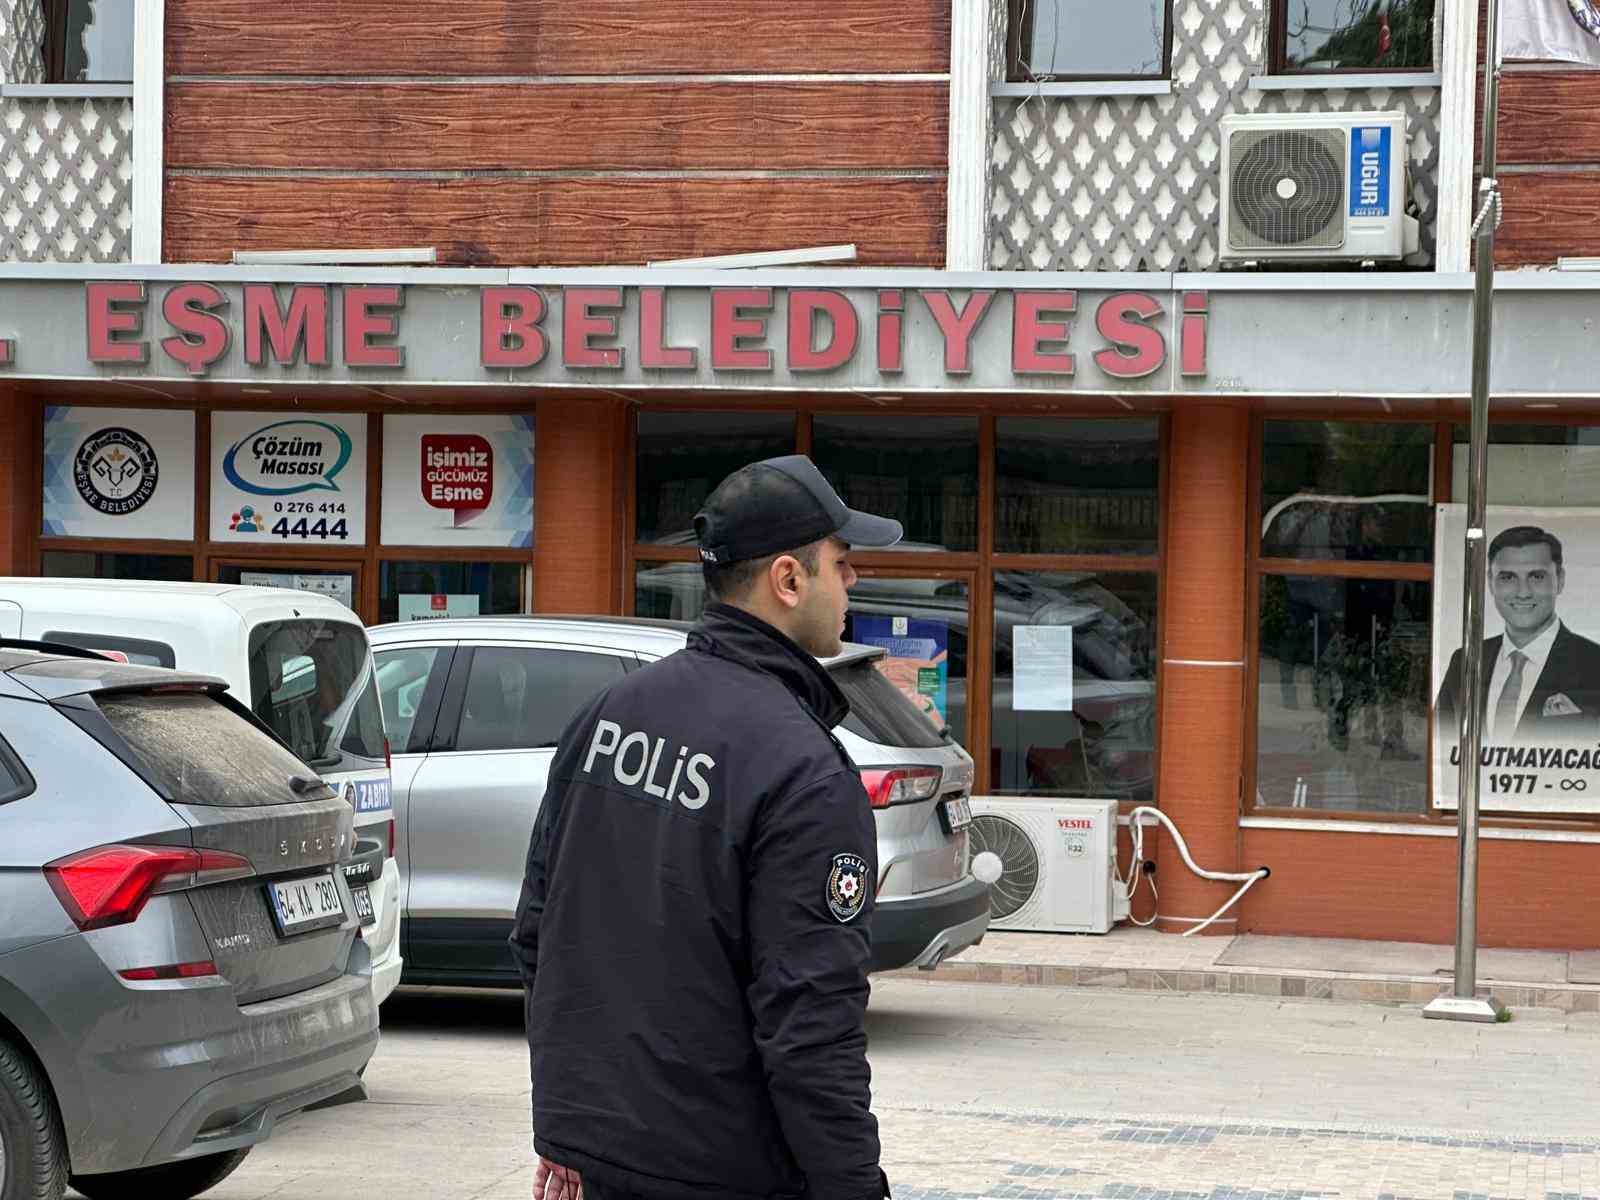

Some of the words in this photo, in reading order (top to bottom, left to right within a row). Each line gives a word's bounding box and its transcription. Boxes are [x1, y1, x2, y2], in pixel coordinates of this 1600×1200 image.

[85, 281, 405, 375] EŞME
[480, 285, 1208, 379] BELEDİYESİ
[252, 436, 323, 459] Çözüm
[260, 458, 325, 476] Masası
[427, 468, 488, 483] GÜCÜMÜZ
[431, 483, 484, 502] Eşme
[273, 502, 283, 513] 0
[285, 502, 315, 514] 276
[318, 502, 346, 514] 414
[271, 517, 349, 540] 4444
[583, 719, 716, 810] POLİS
[1450, 743, 1600, 769] UUTMAYACAĞ
[1489, 773, 1538, 793] 1977
[1057, 819, 1093, 829] VESTEL
[278, 888, 295, 919] 64
[315, 880, 338, 911] 280
